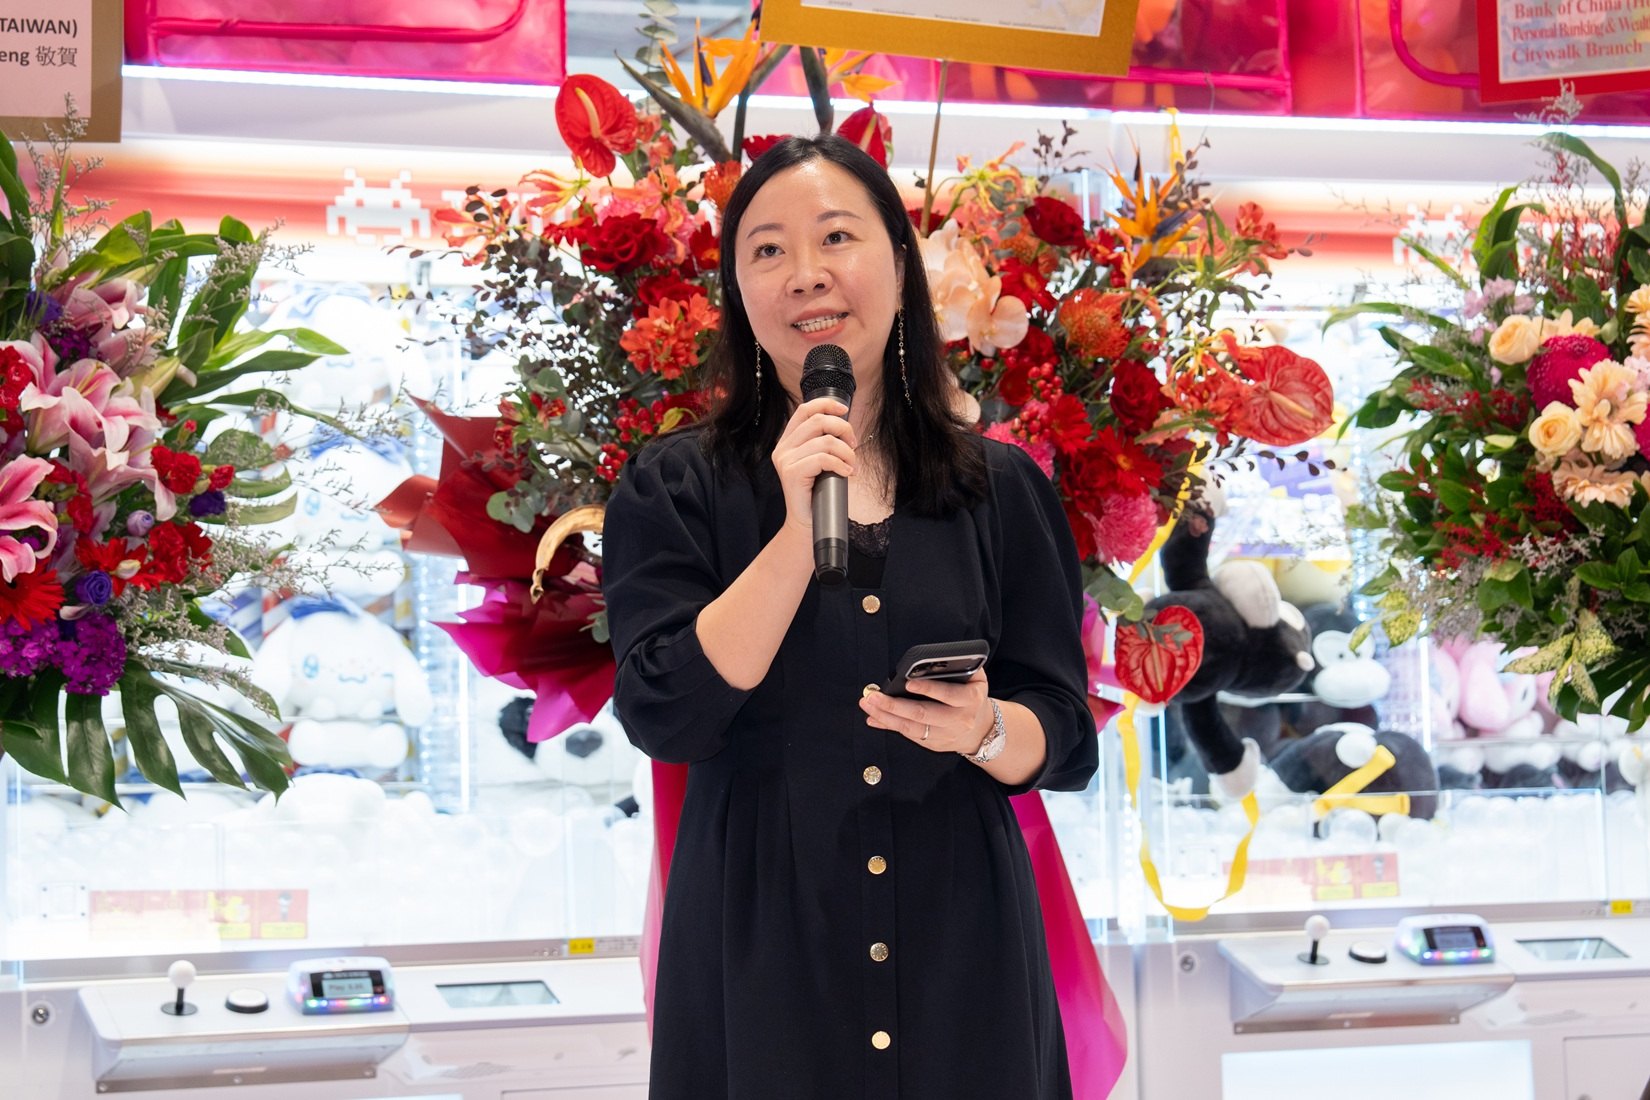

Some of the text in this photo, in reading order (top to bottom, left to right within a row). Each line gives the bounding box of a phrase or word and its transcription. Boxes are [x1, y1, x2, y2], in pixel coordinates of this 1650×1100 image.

[1514, 2, 1553, 19] Bank
[1557, 0, 1572, 15] of
[1576, 0, 1622, 14] China
[1512, 22, 1557, 41] Personal
[1559, 19, 1604, 38] Banking
[1605, 16, 1616, 33] &
[35, 45, 78, 67] 敬賀
[1512, 39, 1643, 66] Citywalk Branch
